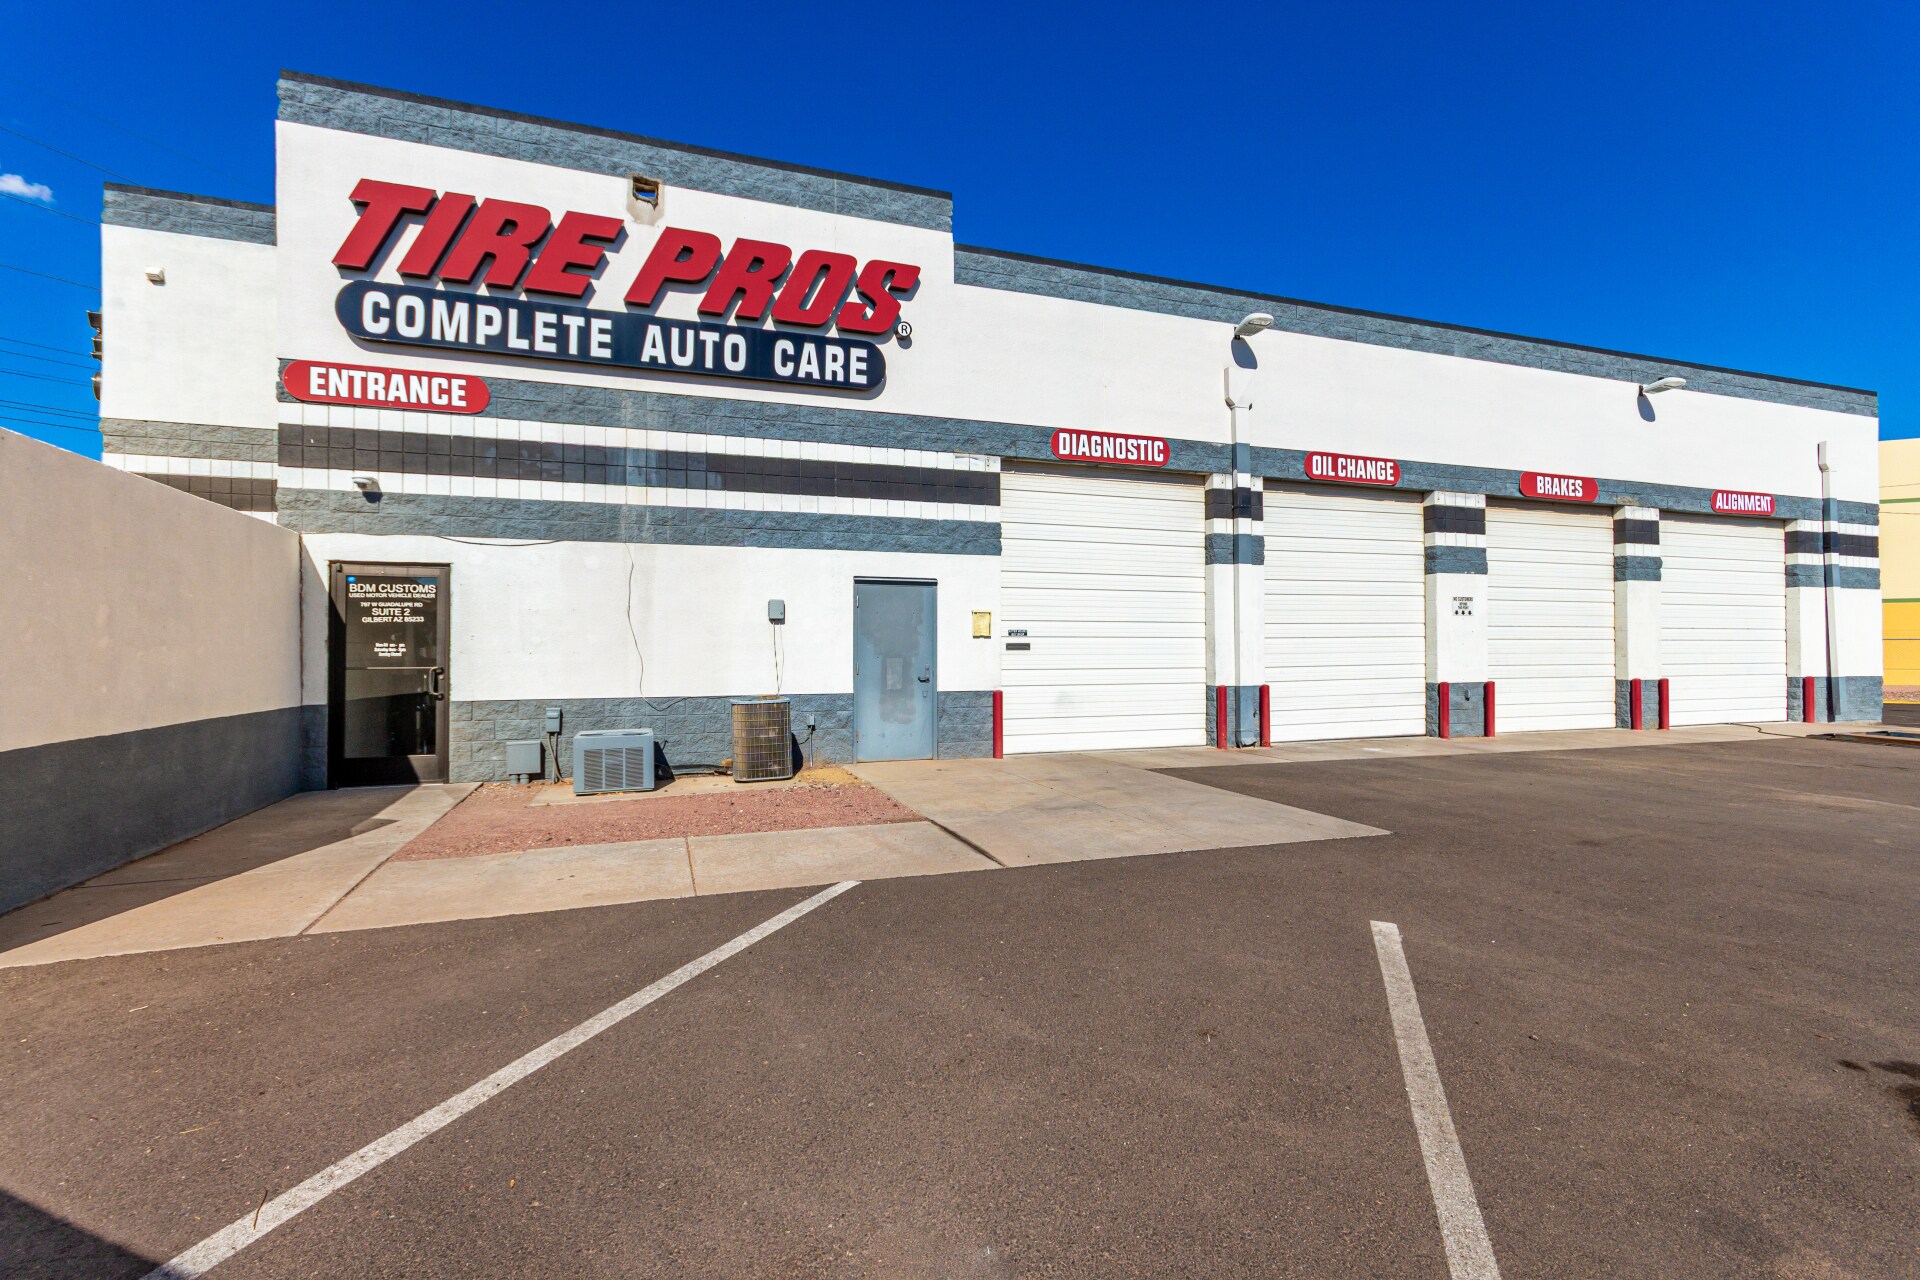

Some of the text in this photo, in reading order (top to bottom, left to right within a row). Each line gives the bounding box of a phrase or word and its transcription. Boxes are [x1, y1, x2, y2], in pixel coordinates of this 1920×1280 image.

[332, 178, 625, 297] TIRE
[624, 227, 921, 334] PROS
[361, 290, 868, 384] COMPLETE AUTO CARE
[309, 366, 467, 407] ENTRANCE
[1058, 432, 1164, 462] DIAGNOSTIC
[1312, 455, 1395, 481] OIL CHANGE
[1536, 475, 1583, 497] BRAKES
[1715, 492, 1772, 512] ALIGNMENT
[349, 584, 436, 593] BDM CUSTOMS
[372, 608, 410, 616] SUITE 2
